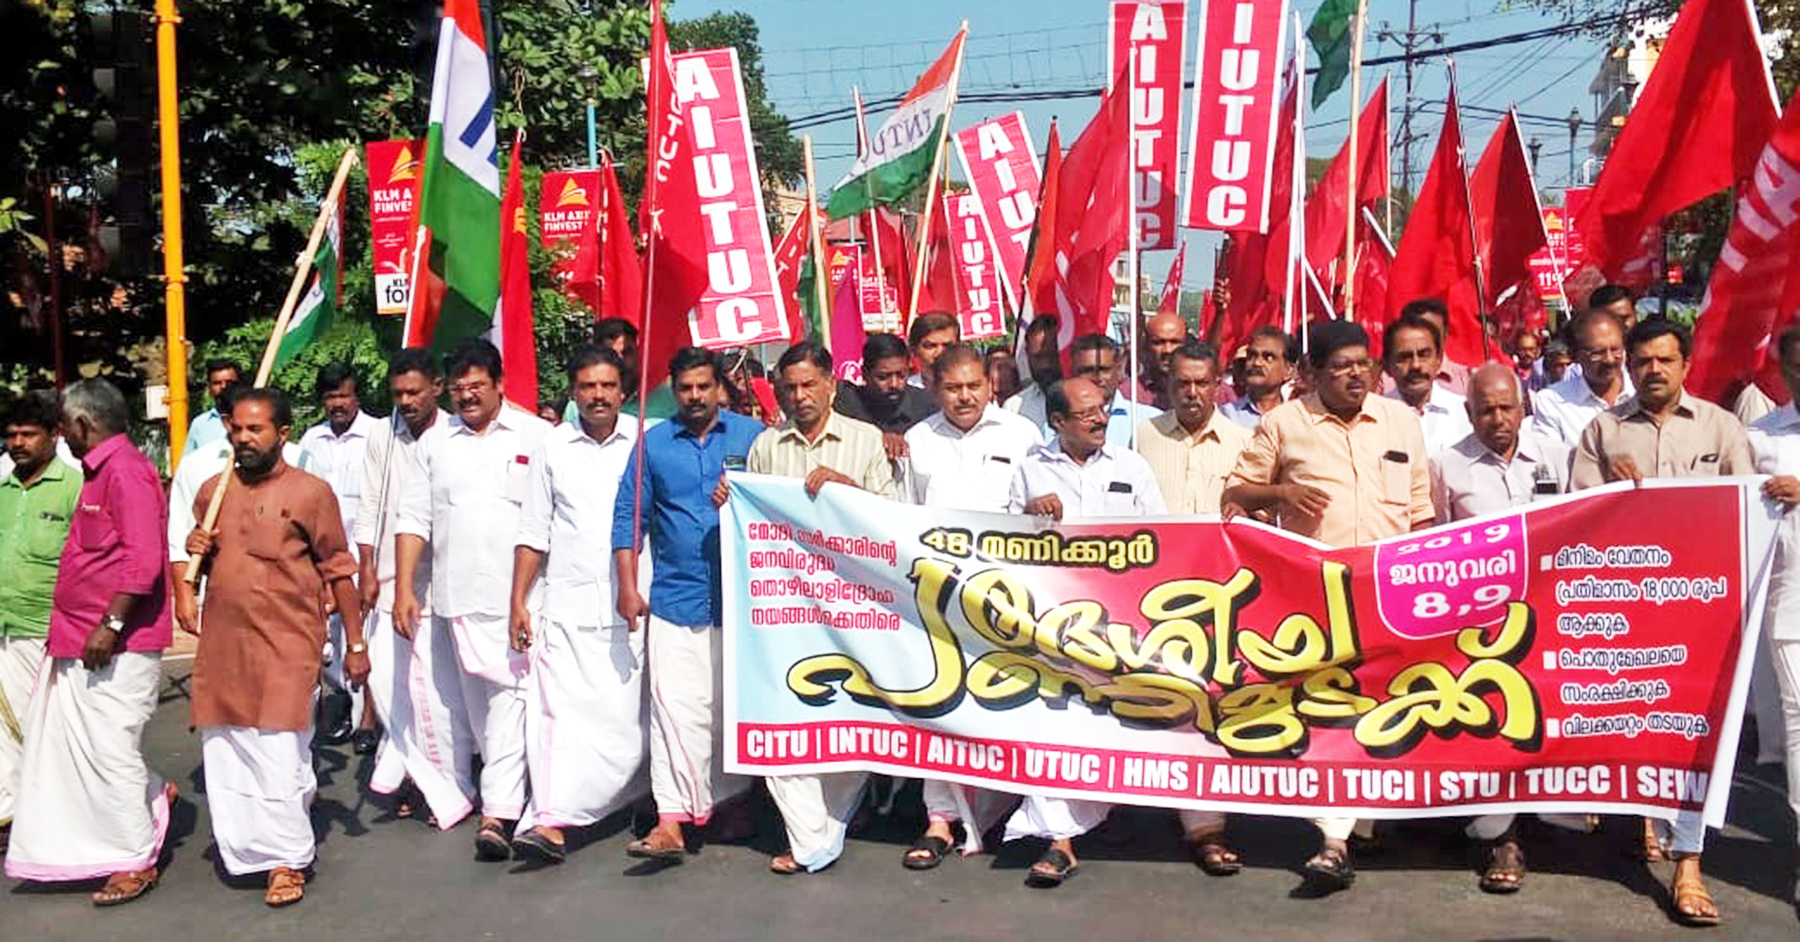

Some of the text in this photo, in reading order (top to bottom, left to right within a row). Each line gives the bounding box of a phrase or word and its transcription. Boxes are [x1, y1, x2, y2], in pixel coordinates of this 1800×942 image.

[1129, 3, 1168, 249] AIUTUC
[1206, 2, 1260, 226] IUTUC
[373, 188, 400, 202] KLM
[676, 56, 762, 342] AIUTUC
[977, 121, 1036, 254] AIUT
[957, 195, 995, 335] AIUTUC
[921, 528, 1156, 571] 48 മണിക്കൂർ
[1398, 524, 1510, 555] 2019
[1557, 544, 1669, 567] മിനിമം വേതനം
[1389, 549, 1516, 587] ജനുവരി
[1412, 585, 1511, 619] 8,9
[1558, 577, 1726, 604] പ്രതിമാസം 18,000 രൂപ
[1559, 614, 1626, 638] ആക്കുക
[1563, 680, 1668, 704] സംരക്ഷിക്കുക
[1564, 714, 1709, 738] വിലക്കയറ്റം തടയുക
[747, 729, 808, 758] CITU
[829, 727, 907, 758] INTUC
[927, 735, 1004, 772] AITUC
[1025, 749, 1100, 783] UTUC
[1123, 758, 1188, 791] HMS
[1210, 763, 1319, 799] AIUTUC
[1343, 767, 1415, 801] TUCI
[1439, 770, 1500, 800] STU
[1525, 765, 1611, 795] TUCC
